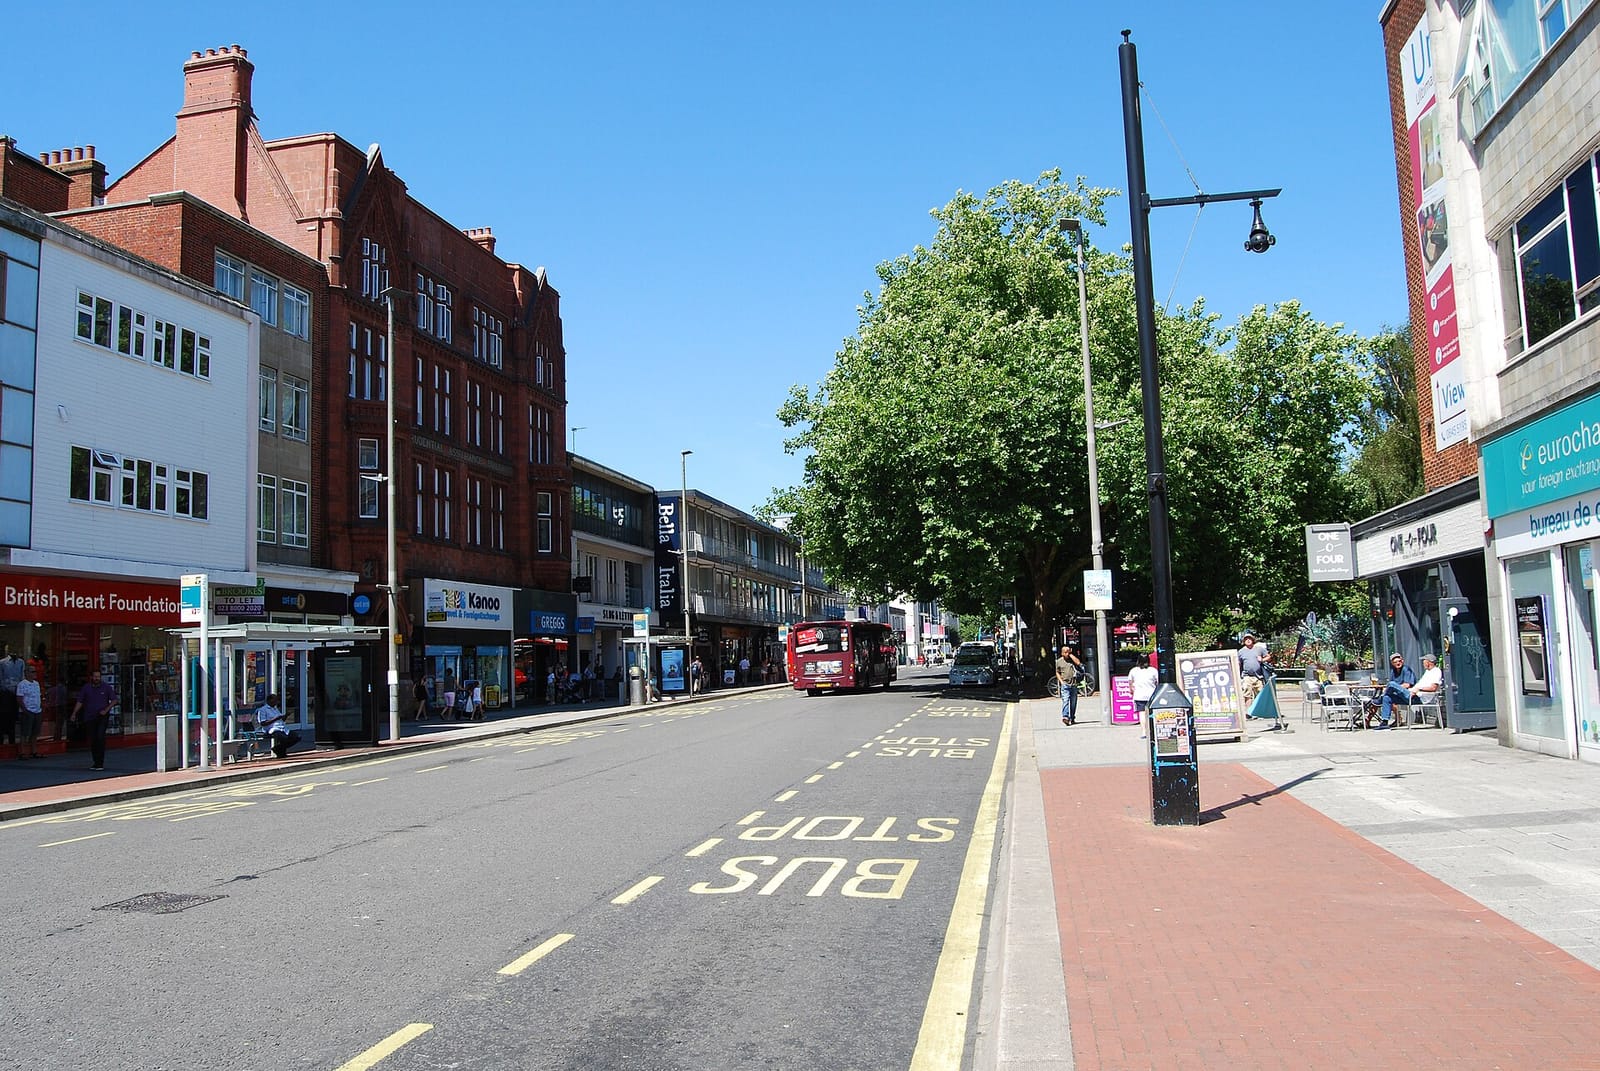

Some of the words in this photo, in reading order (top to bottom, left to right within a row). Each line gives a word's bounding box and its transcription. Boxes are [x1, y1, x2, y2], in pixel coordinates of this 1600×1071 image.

[1442, 383, 1465, 408] View
[1538, 468, 1563, 489] foreign
[659, 503, 675, 544] Bella
[1530, 510, 1570, 538] bureau
[1574, 500, 1591, 528] de
[1318, 532, 1339, 540] ONE
[1316, 554, 1344, 564] FOUR
[659, 566, 675, 608] Italia
[5, 586, 59, 608] British
[64, 590, 105, 610] Heart
[468, 592, 500, 610] Kanoo
[541, 615, 565, 630] GREGGS
[1200, 671, 1230, 688] £10
[880, 737, 991, 747] STOP
[875, 747, 977, 759] BUS
[738, 816, 960, 842] STOP
[688, 855, 920, 900] BUS
